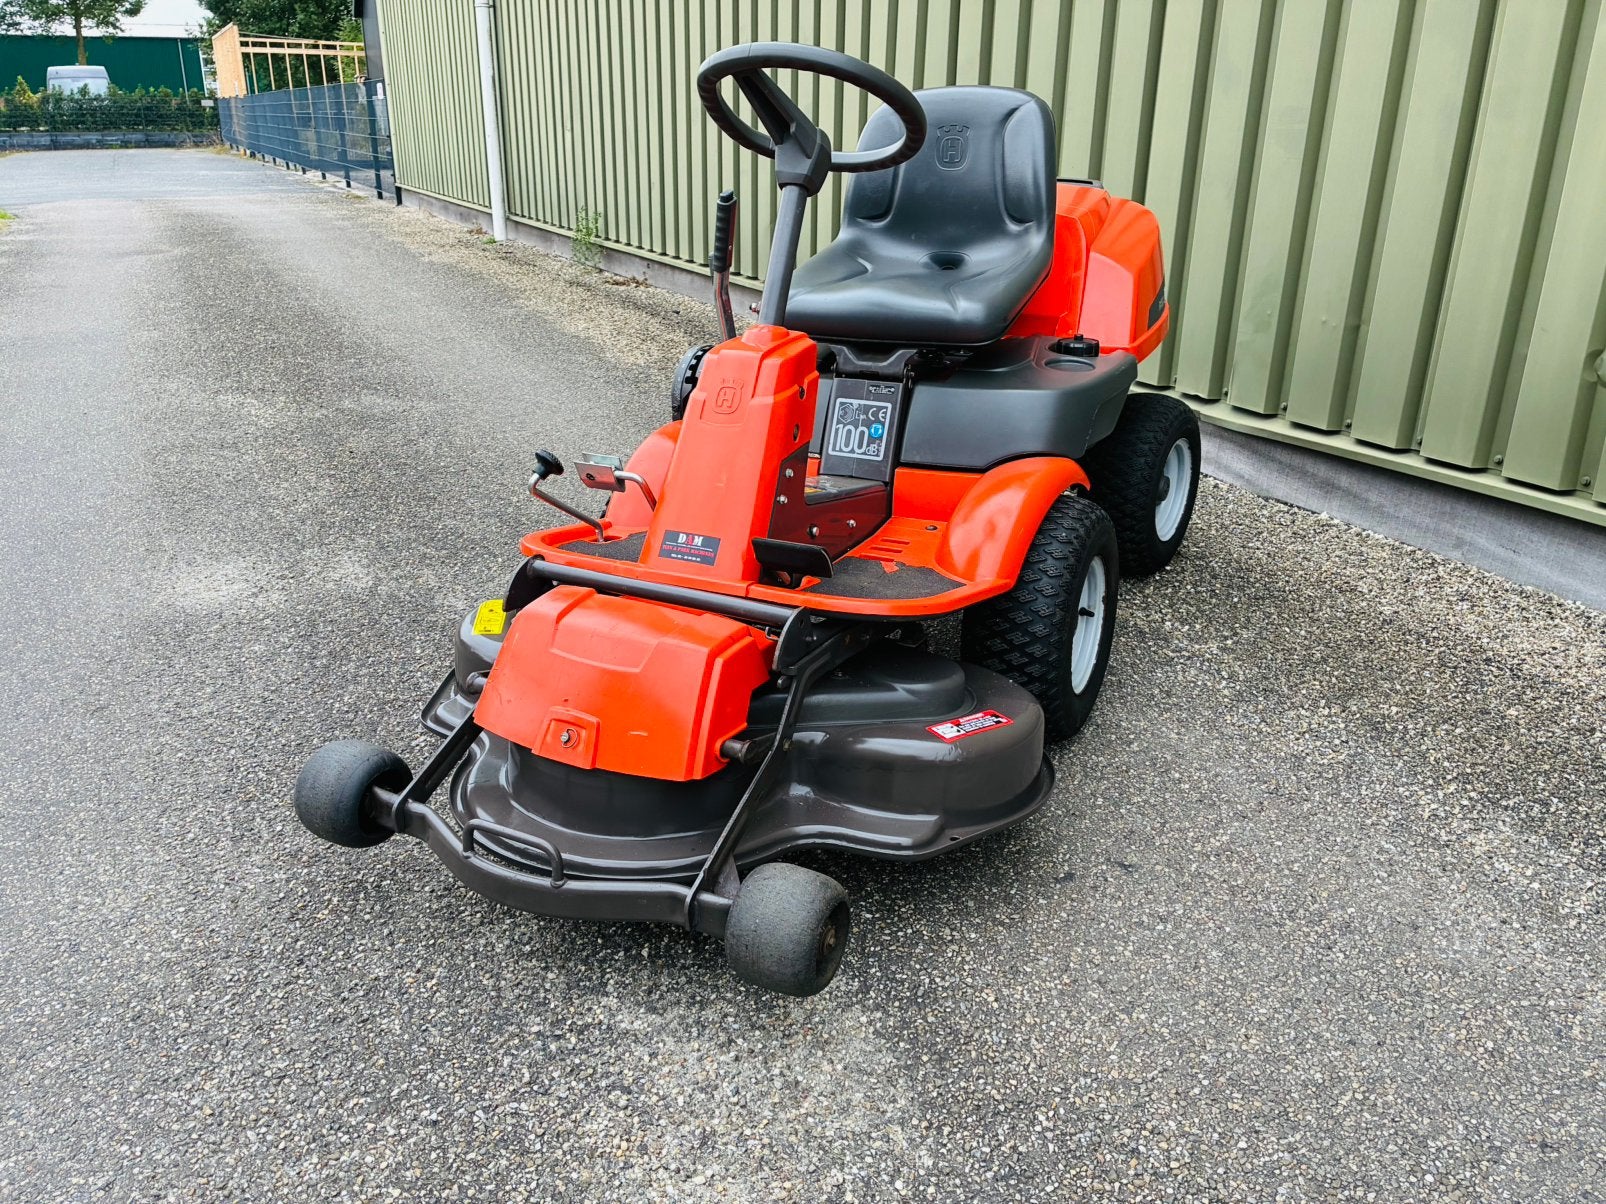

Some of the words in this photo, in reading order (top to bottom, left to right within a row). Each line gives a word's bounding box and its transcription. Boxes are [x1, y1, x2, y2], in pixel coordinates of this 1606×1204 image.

[868, 407, 887, 422] CE
[835, 424, 869, 454] 100
[677, 532, 704, 546] DAM
